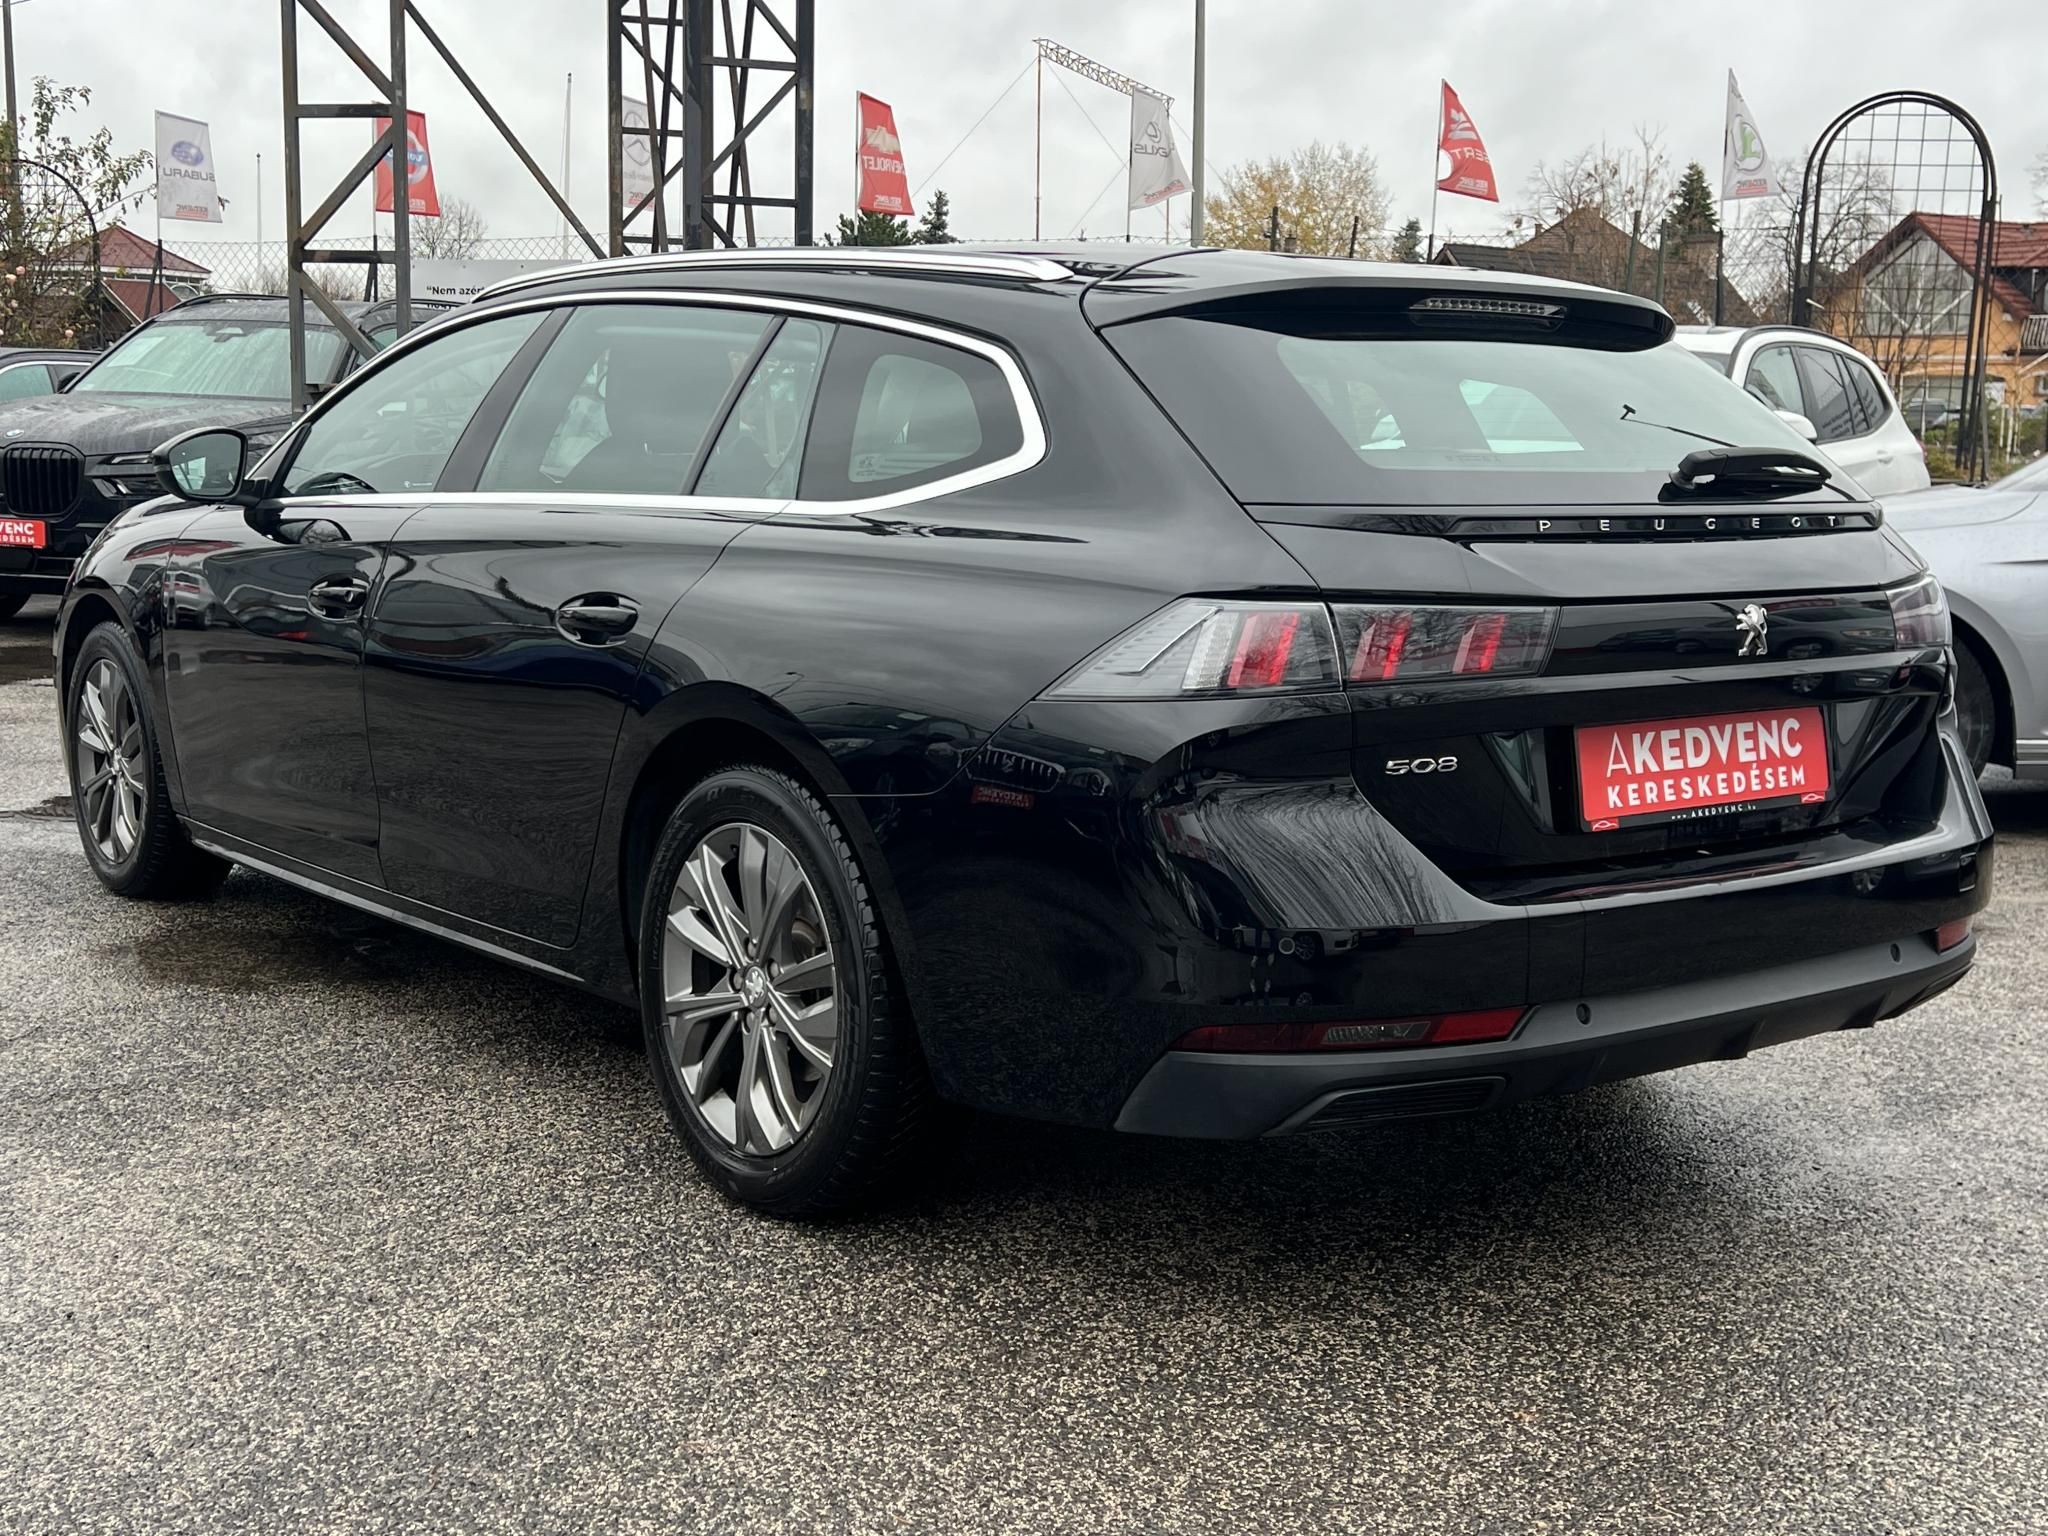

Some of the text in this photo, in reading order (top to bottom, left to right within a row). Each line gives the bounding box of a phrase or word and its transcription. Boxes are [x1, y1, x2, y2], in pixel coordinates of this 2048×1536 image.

[1538, 515, 1837, 532] PEUGEOT
[0, 533, 35, 544] DÉSEM
[1606, 717, 1803, 778] AKEDVENC
[1384, 756, 1458, 775] 508
[1606, 763, 1806, 809] KERESKEDÉSEM
